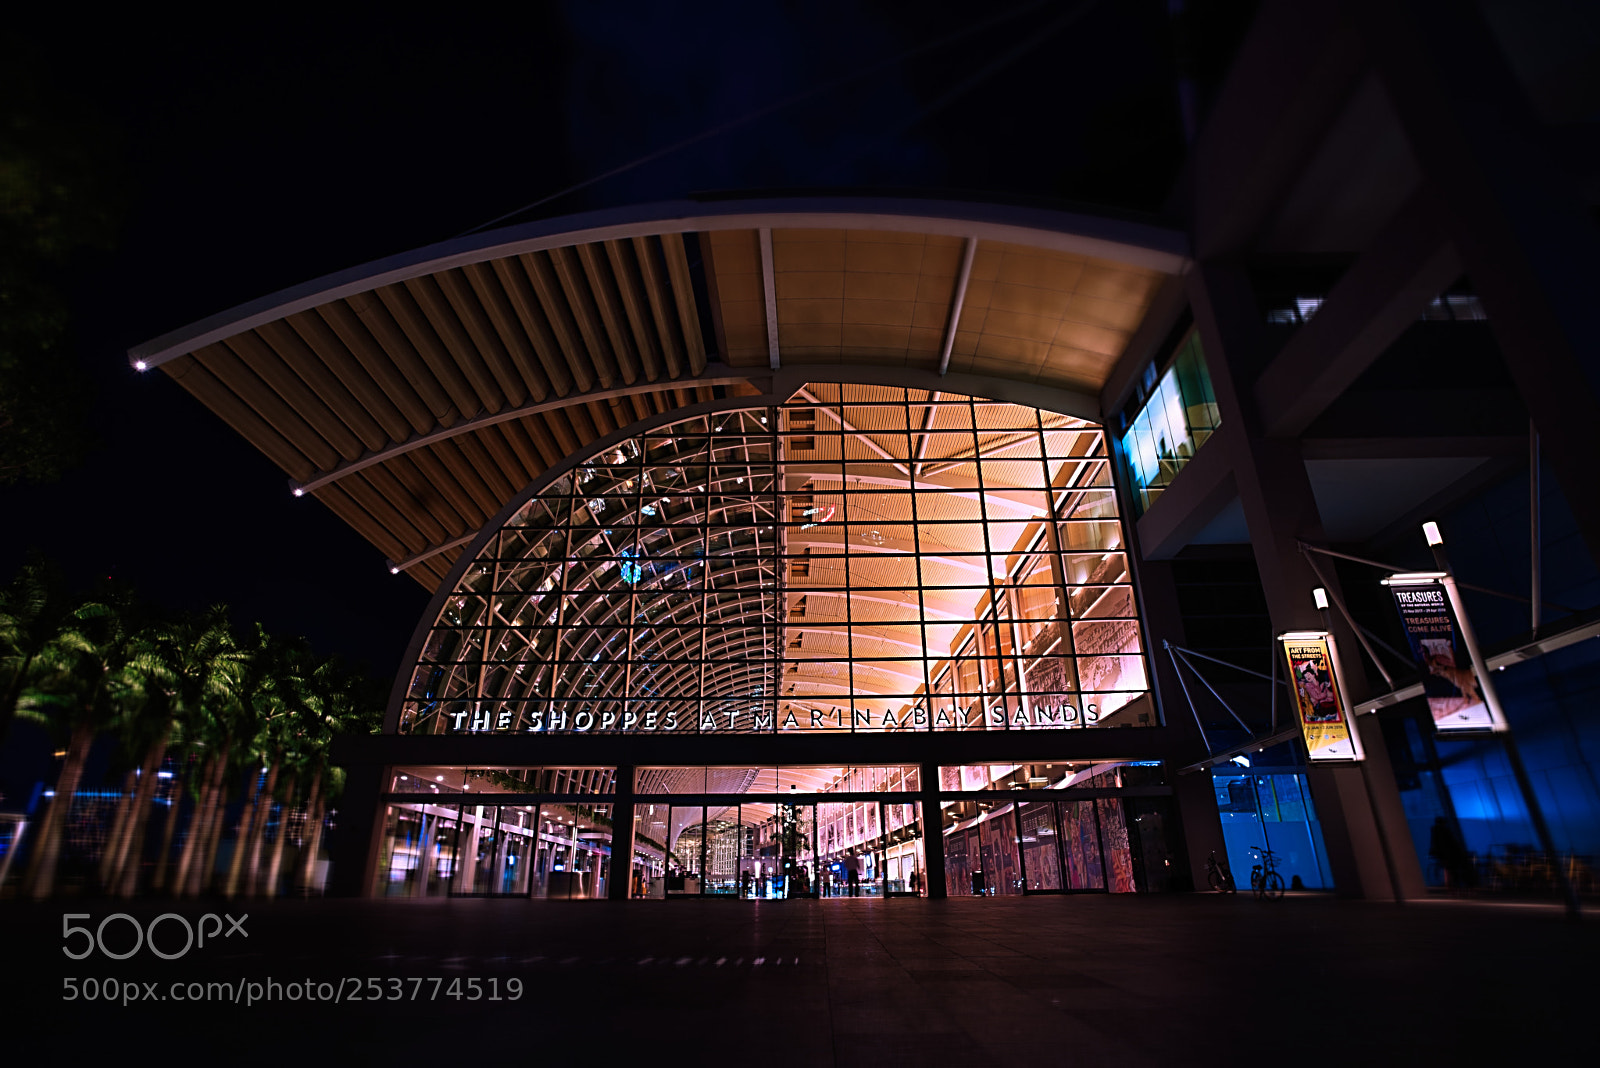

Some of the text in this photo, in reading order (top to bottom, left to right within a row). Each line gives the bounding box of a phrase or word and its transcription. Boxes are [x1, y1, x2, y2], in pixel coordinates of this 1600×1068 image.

[1396, 591, 1444, 603] TREASURES
[1405, 616, 1450, 625] TREASURES
[1407, 624, 1453, 633] COME ALIVE
[450, 703, 1099, 732] THE SHOPPES AT MARINA BAY SANDS
